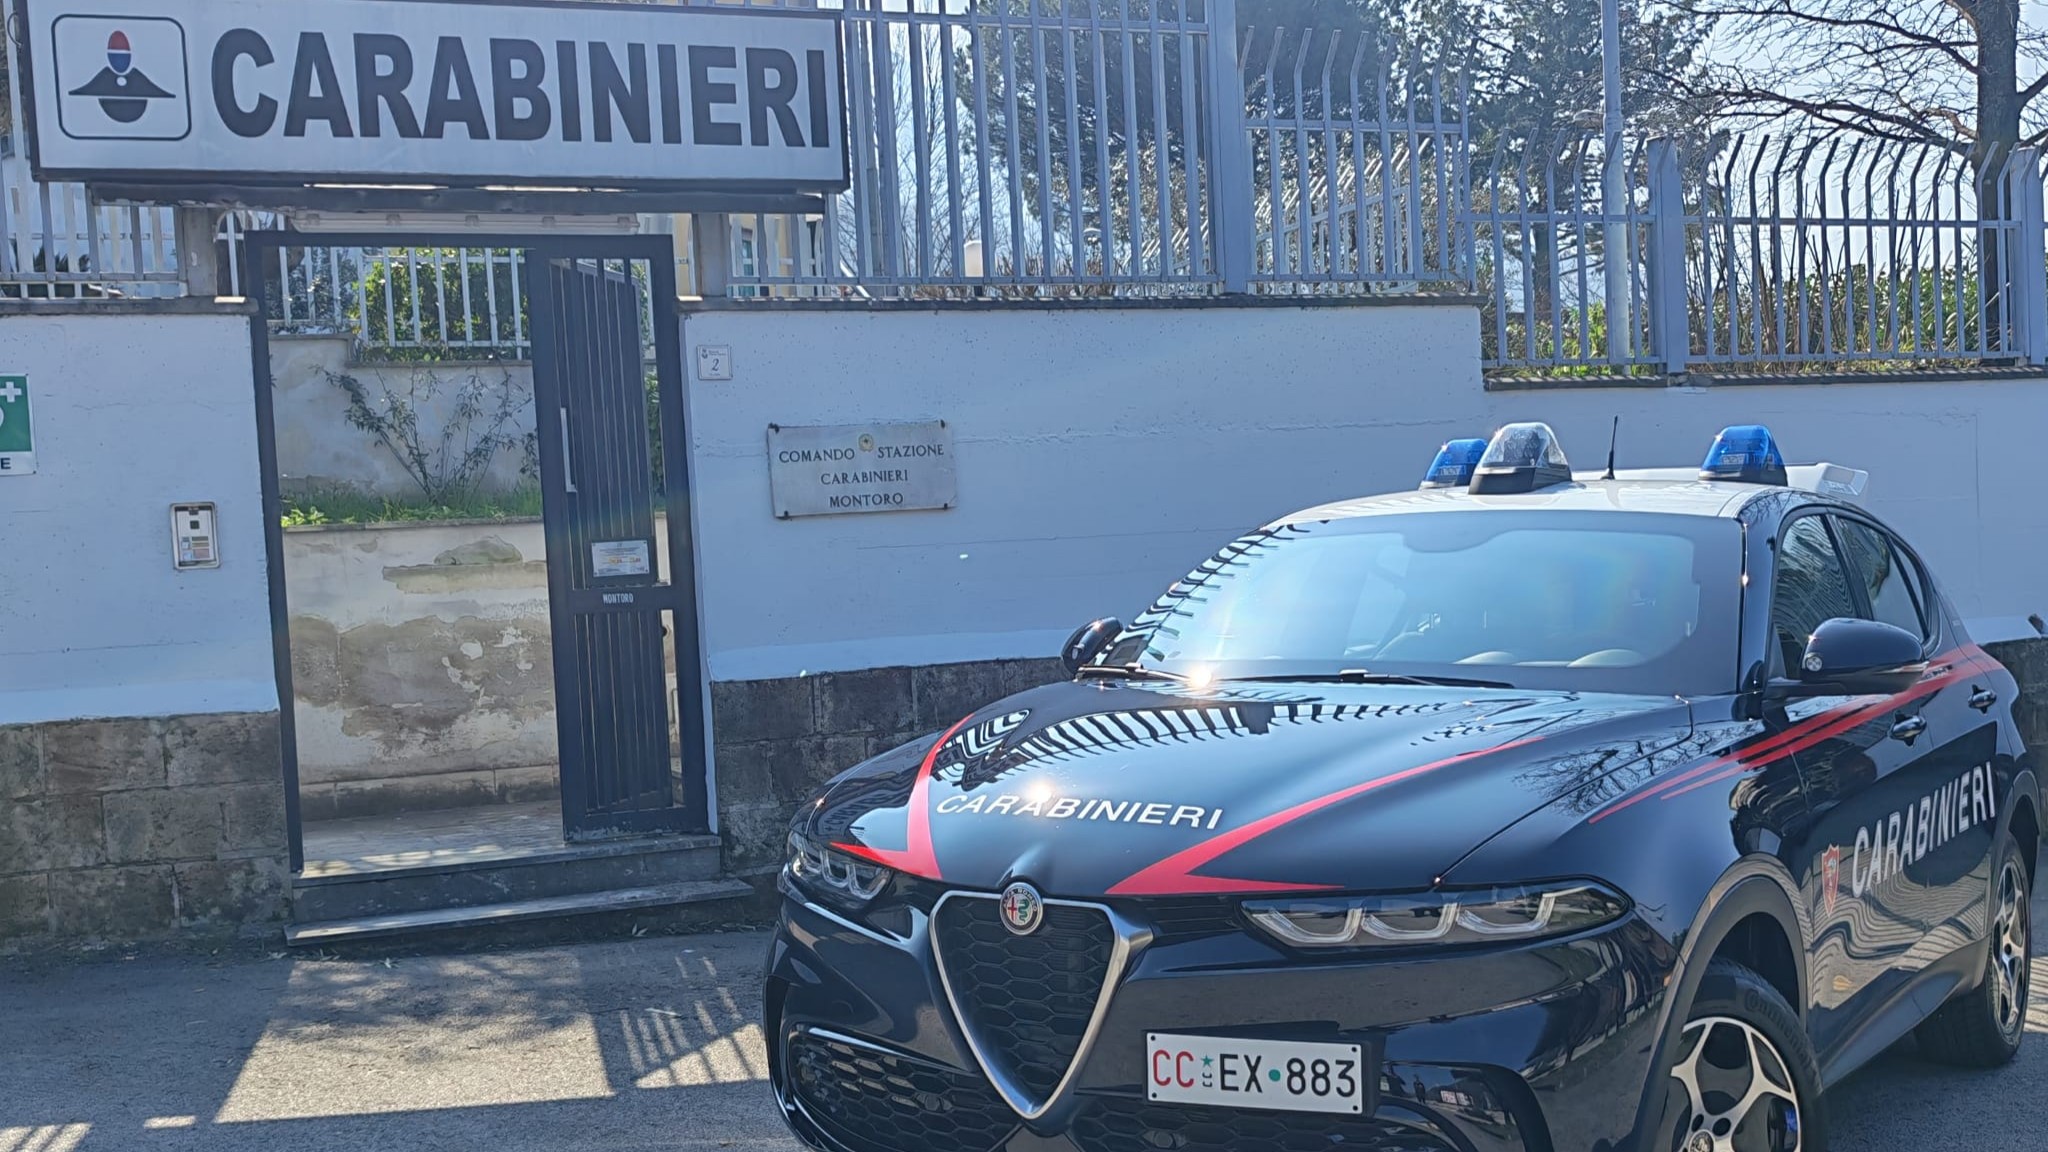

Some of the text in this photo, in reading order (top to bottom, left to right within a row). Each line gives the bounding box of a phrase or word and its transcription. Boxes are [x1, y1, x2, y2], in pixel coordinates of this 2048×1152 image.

[212, 28, 829, 148] CARABINIERI
[711, 358, 720, 371] 2
[779, 444, 944, 463] COMANDO STAZIONE
[820, 469, 908, 485] CARABINIERI
[829, 492, 903, 508] MONTORO
[602, 592, 634, 605] MONTORO
[936, 794, 1224, 830] CARABINIERI
[1852, 760, 1996, 899] CARABINIERI
[1152, 1049, 1356, 1098] CC EX 883
